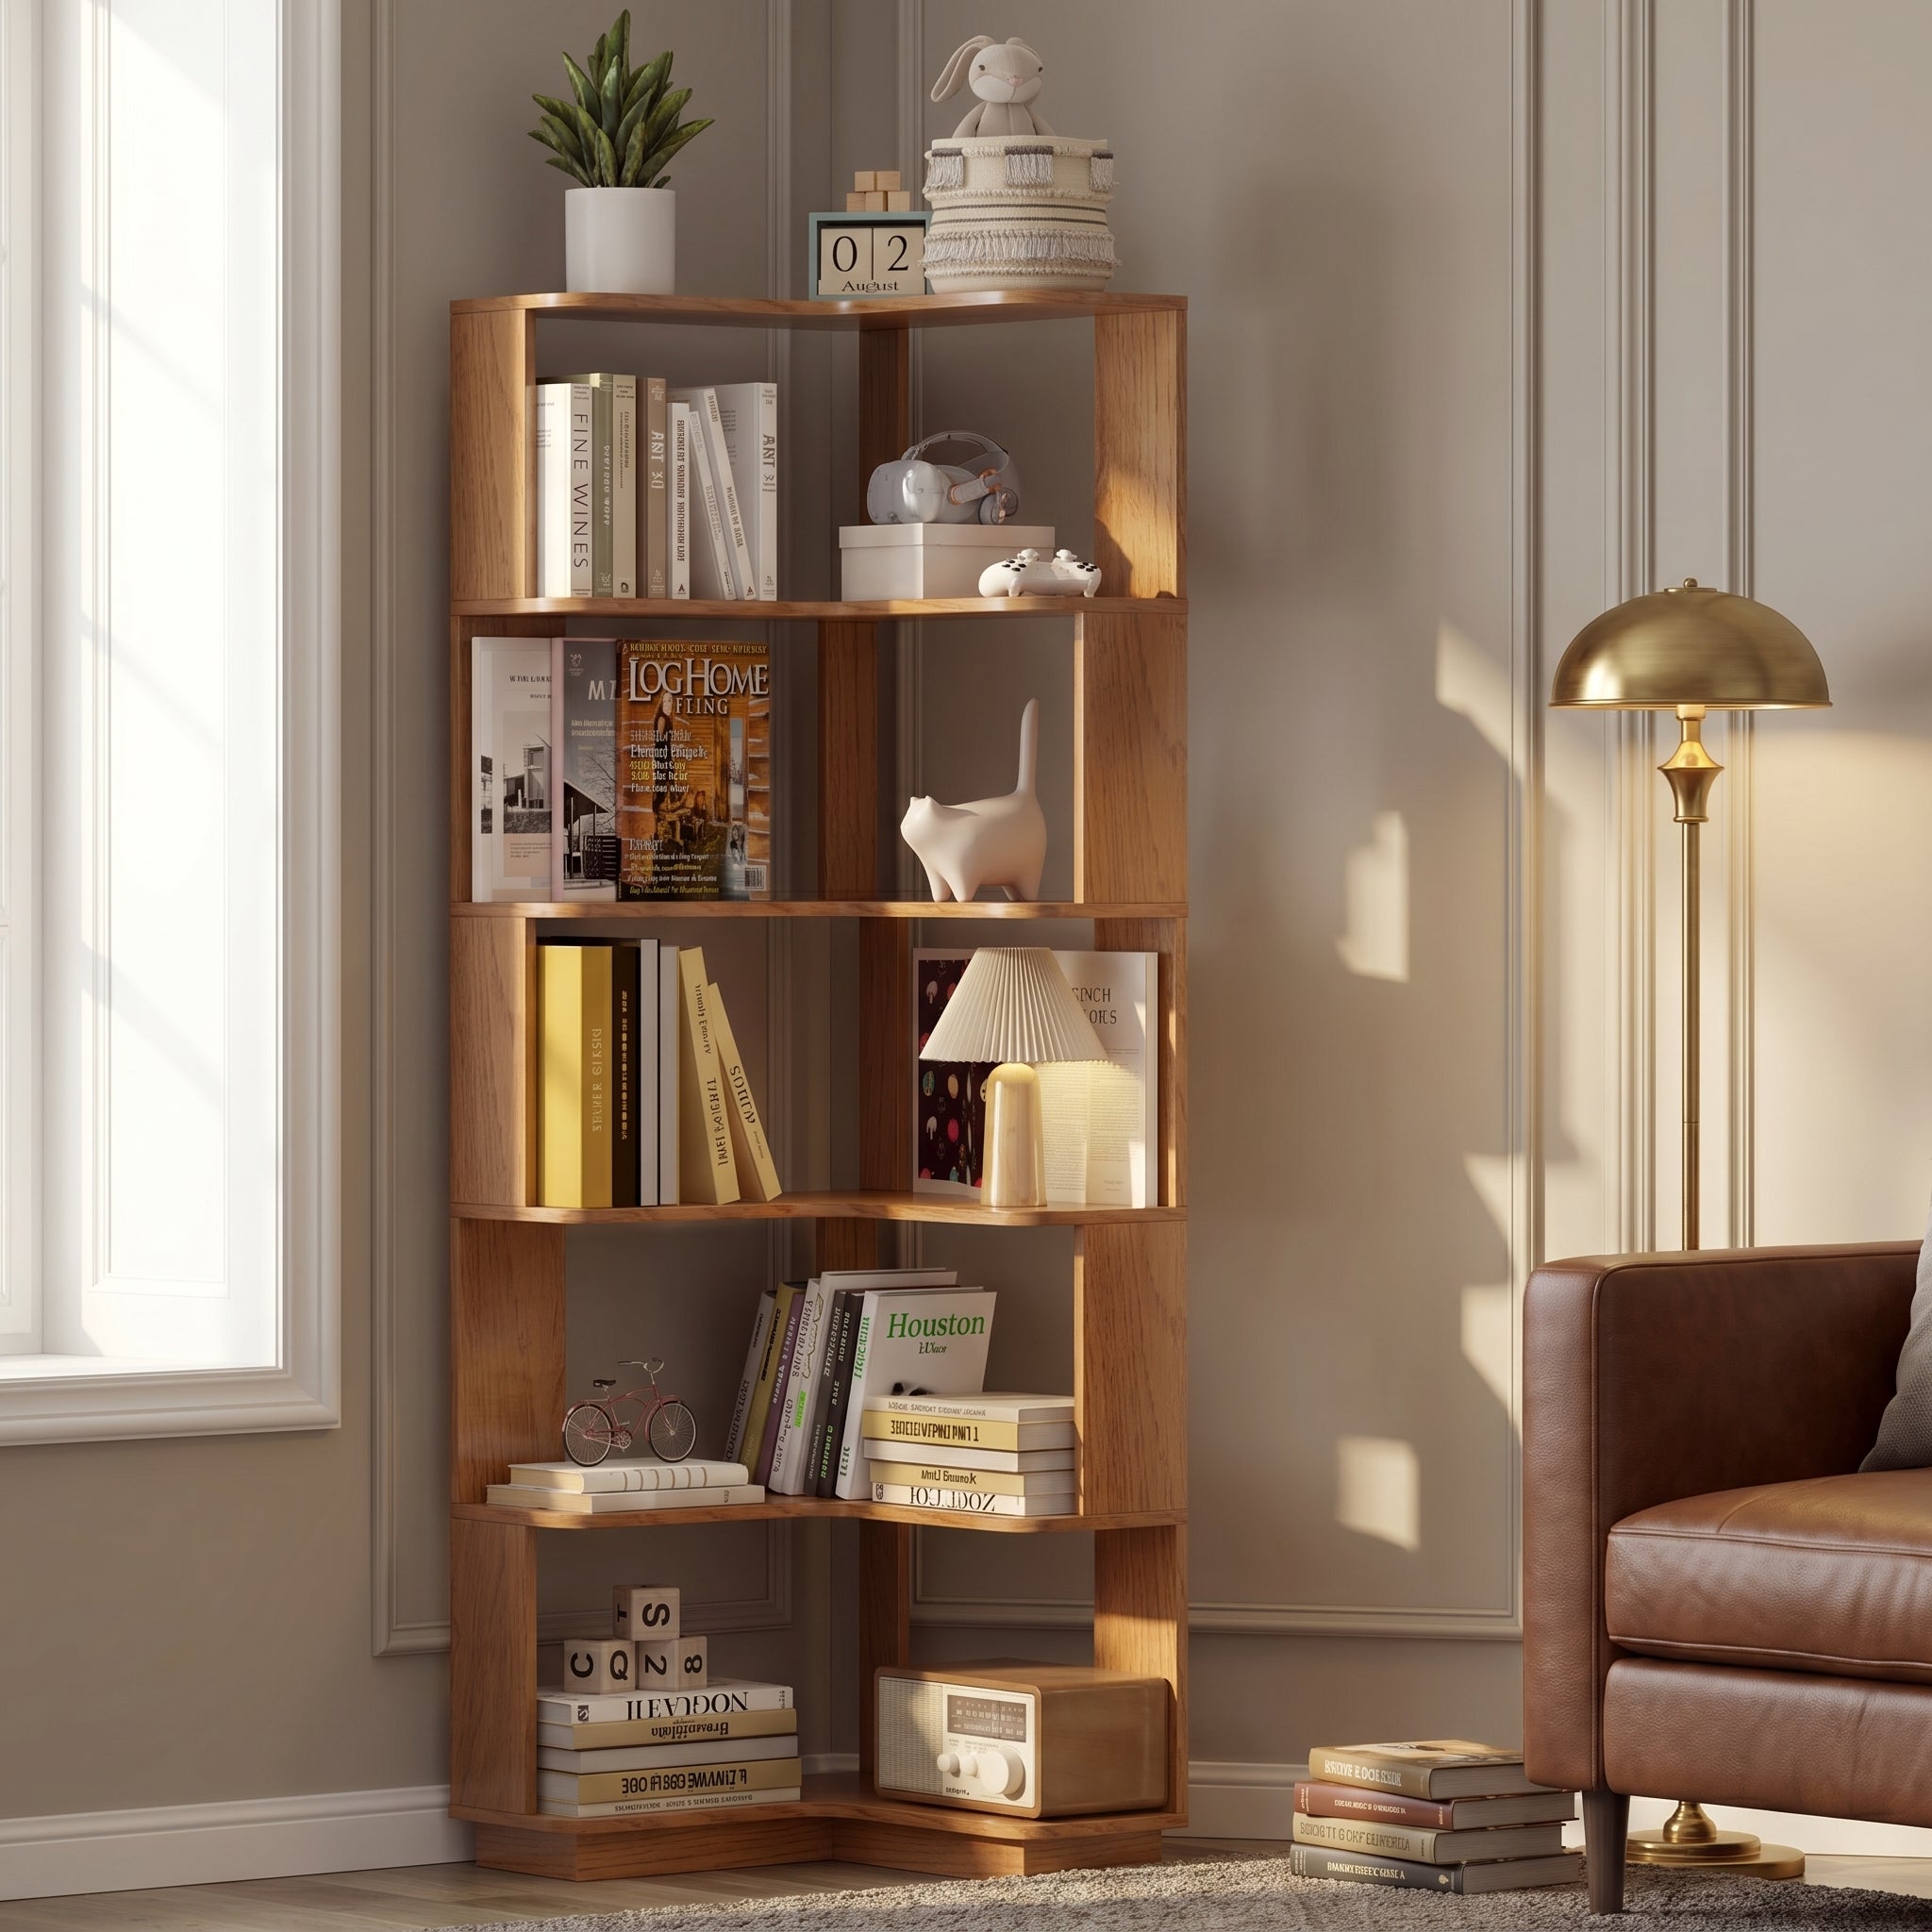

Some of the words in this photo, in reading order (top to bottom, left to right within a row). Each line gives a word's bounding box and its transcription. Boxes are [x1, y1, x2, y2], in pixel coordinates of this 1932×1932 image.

[887, 235, 908, 272] 2
[841, 280, 899, 293] August
[574, 413, 589, 470] FINE
[574, 483, 589, 568] WINES
[886, 1312, 985, 1339] Houston
[641, 1603, 671, 1627] S
[570, 1652, 594, 1678] C
[609, 1649, 628, 1681] Q
[684, 1654, 703, 1674] 8
